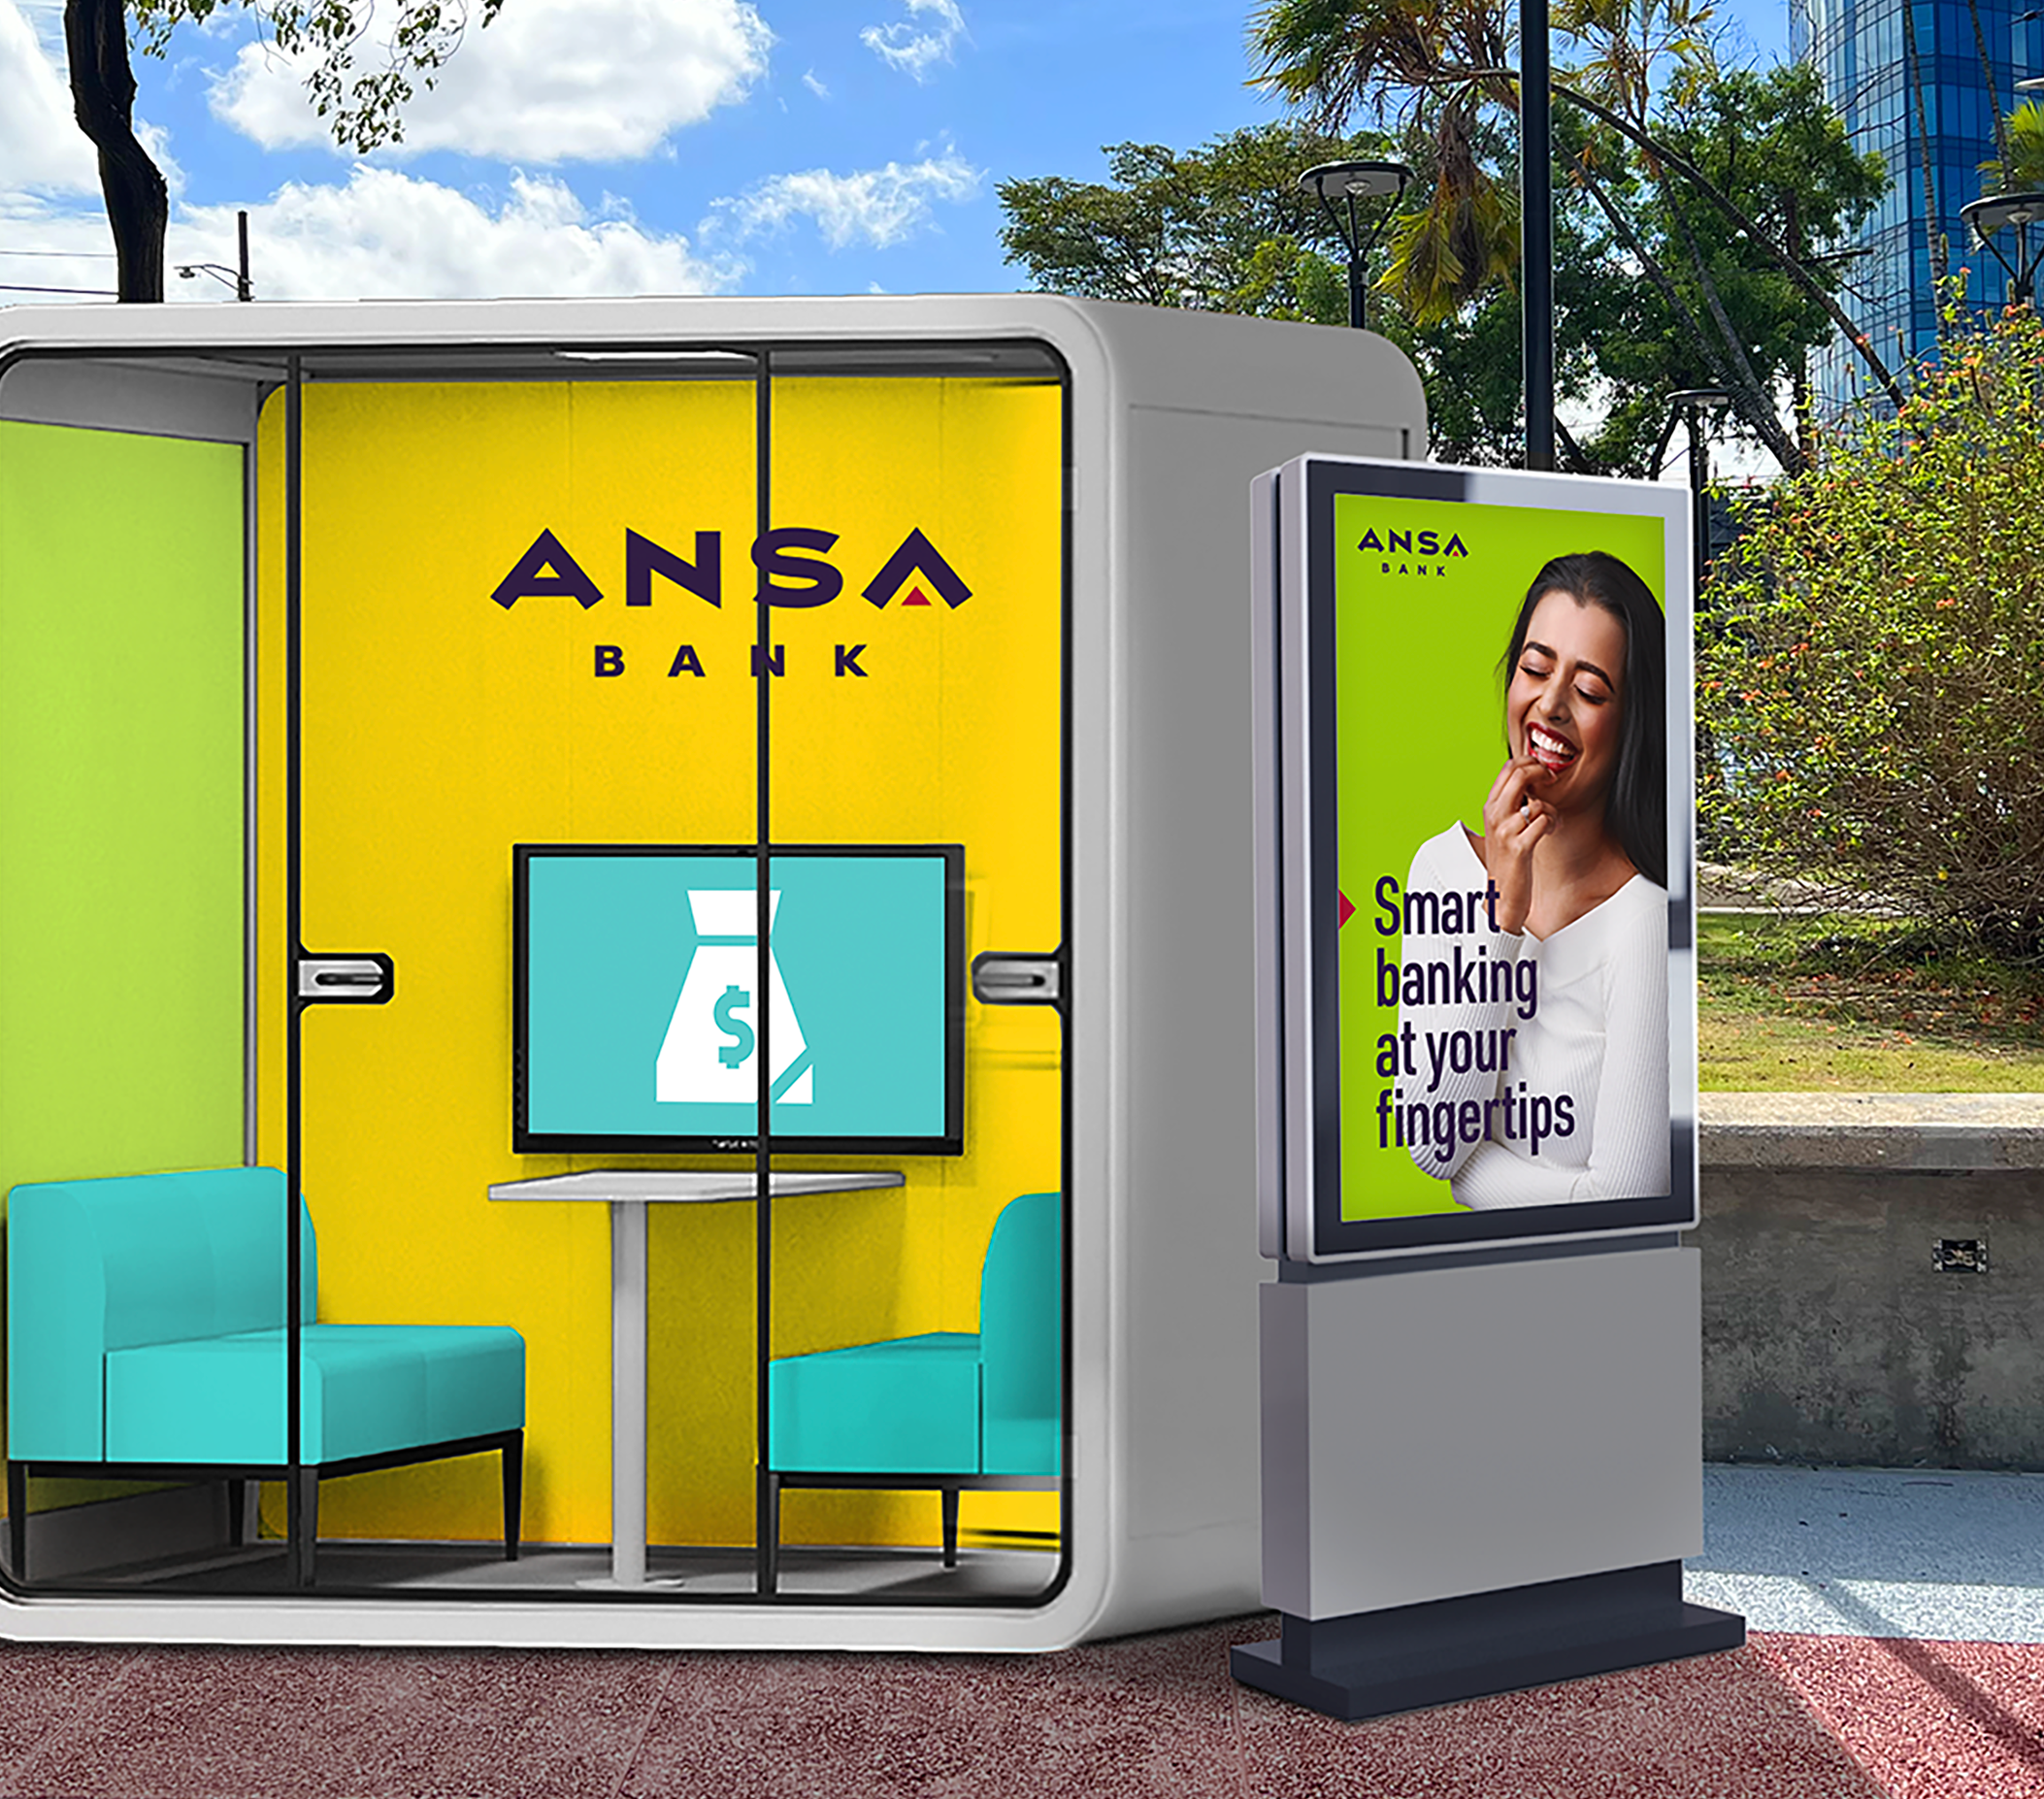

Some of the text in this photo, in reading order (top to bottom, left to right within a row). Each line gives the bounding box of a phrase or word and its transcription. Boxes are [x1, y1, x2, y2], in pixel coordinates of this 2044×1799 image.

[490, 527, 973, 610] ANSA
[1357, 527, 1469, 558] ANSA
[1381, 562, 1446, 577] BANK
[594, 644, 869, 677] BANK
[1374, 875, 1501, 936] Smart
[1376, 945, 1537, 1020] banking
[1375, 1021, 1517, 1094] at your
[1375, 1081, 1576, 1163] fingertips
